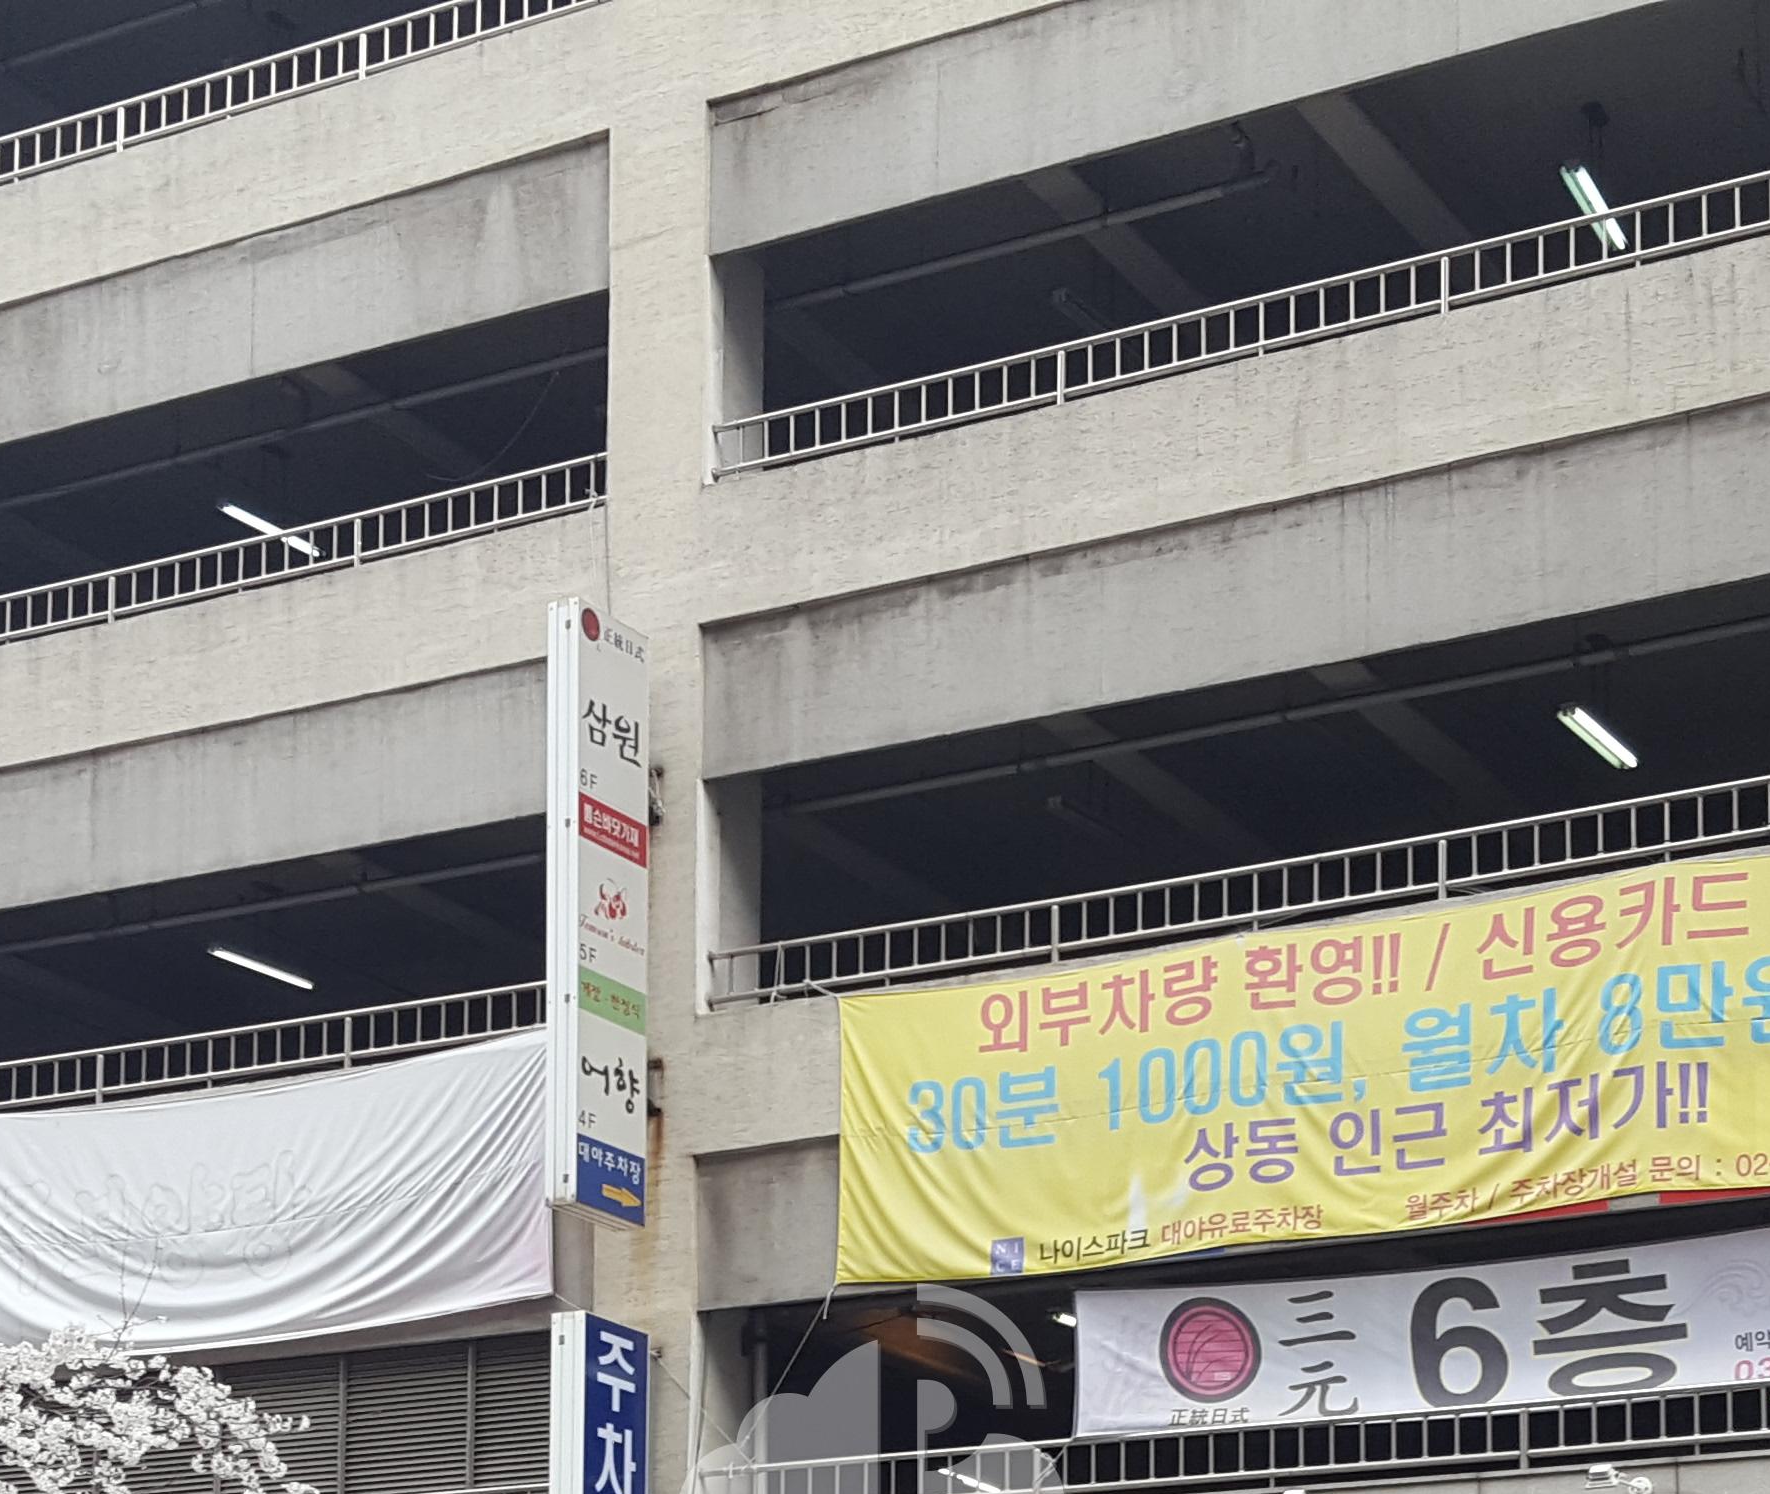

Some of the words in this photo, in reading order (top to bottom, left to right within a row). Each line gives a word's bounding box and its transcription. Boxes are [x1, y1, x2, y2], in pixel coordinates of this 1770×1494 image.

[582, 699, 642, 768] 삼원
[580, 768, 598, 789] 6F
[580, 943, 597, 963] 5F
[977, 955, 1218, 1053] 외부차량
[1243, 932, 1403, 1011] 환영!!
[1476, 871, 1752, 980] 신용카드
[581, 1055, 641, 1115] 어향
[907, 1065, 1060, 1154] 30분
[1402, 985, 1563, 1095] 월차
[579, 1109, 596, 1129] 4F
[1183, 1116, 1299, 1192] 상동
[1328, 1103, 1448, 1176] 인근
[1477, 1061, 1710, 1156] 최저가!!
[1038, 1227, 1151, 1265] 나이스파크
[1160, 1203, 1324, 1246] 대야유료주차장
[1406, 1181, 1480, 1222] 월주차
[1509, 1161, 1640, 1206] 주차장개설
[1648, 1155, 1701, 1183] 문의
[1409, 1259, 1689, 1409] 6층
[1169, 1406, 1249, 1427] 正統日式
